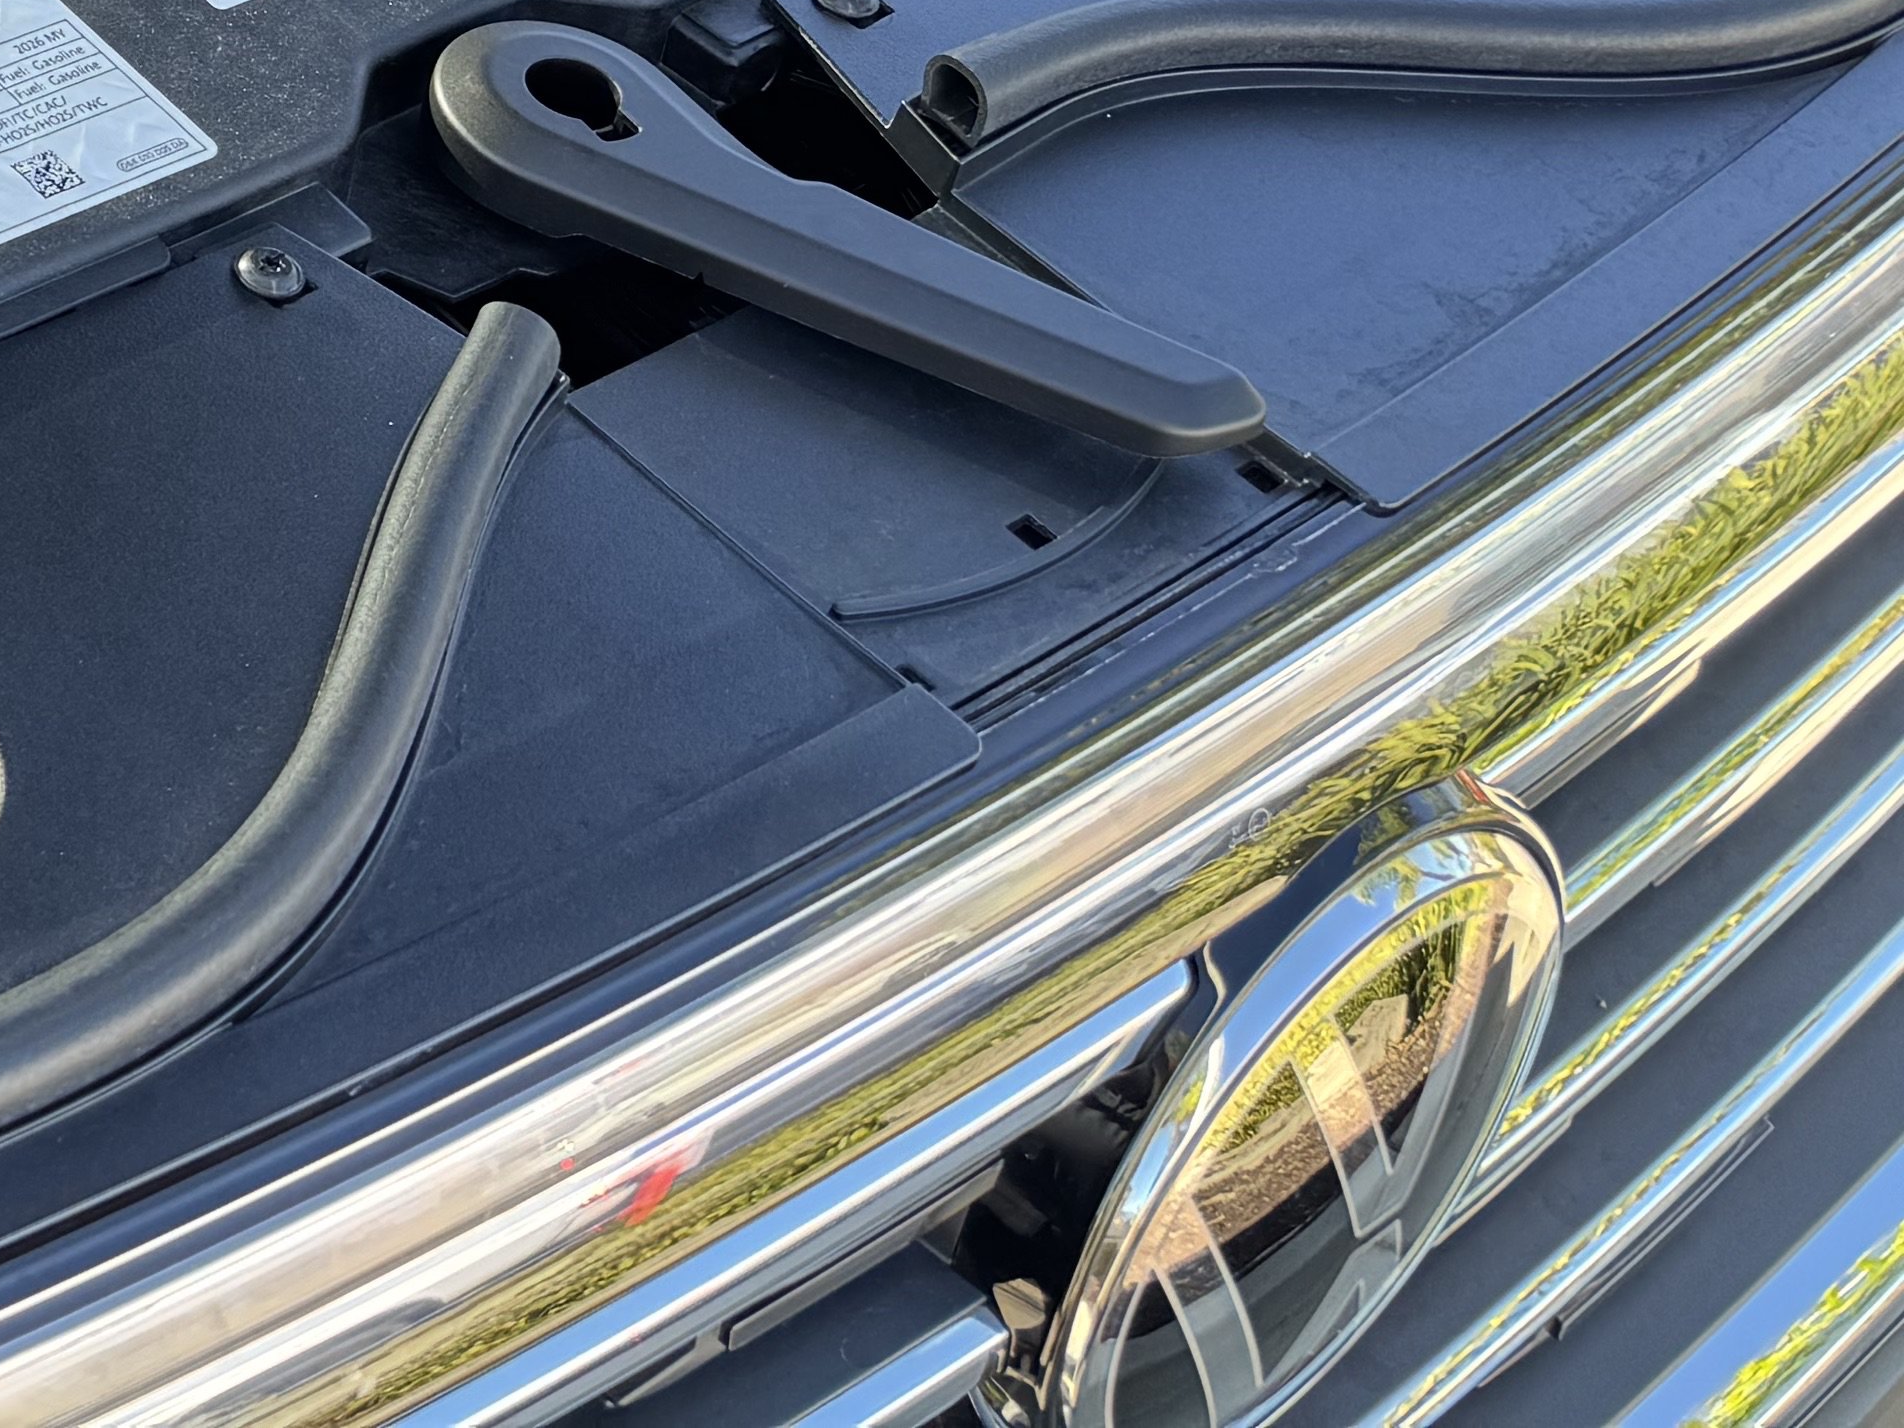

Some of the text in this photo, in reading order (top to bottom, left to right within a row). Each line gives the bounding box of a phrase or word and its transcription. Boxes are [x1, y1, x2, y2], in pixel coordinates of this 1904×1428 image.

[12, 28, 65, 54] 2026 MY
[31, 46, 85, 70] Gasoline
[13, 61, 101, 99] Fuel: Gasoline
